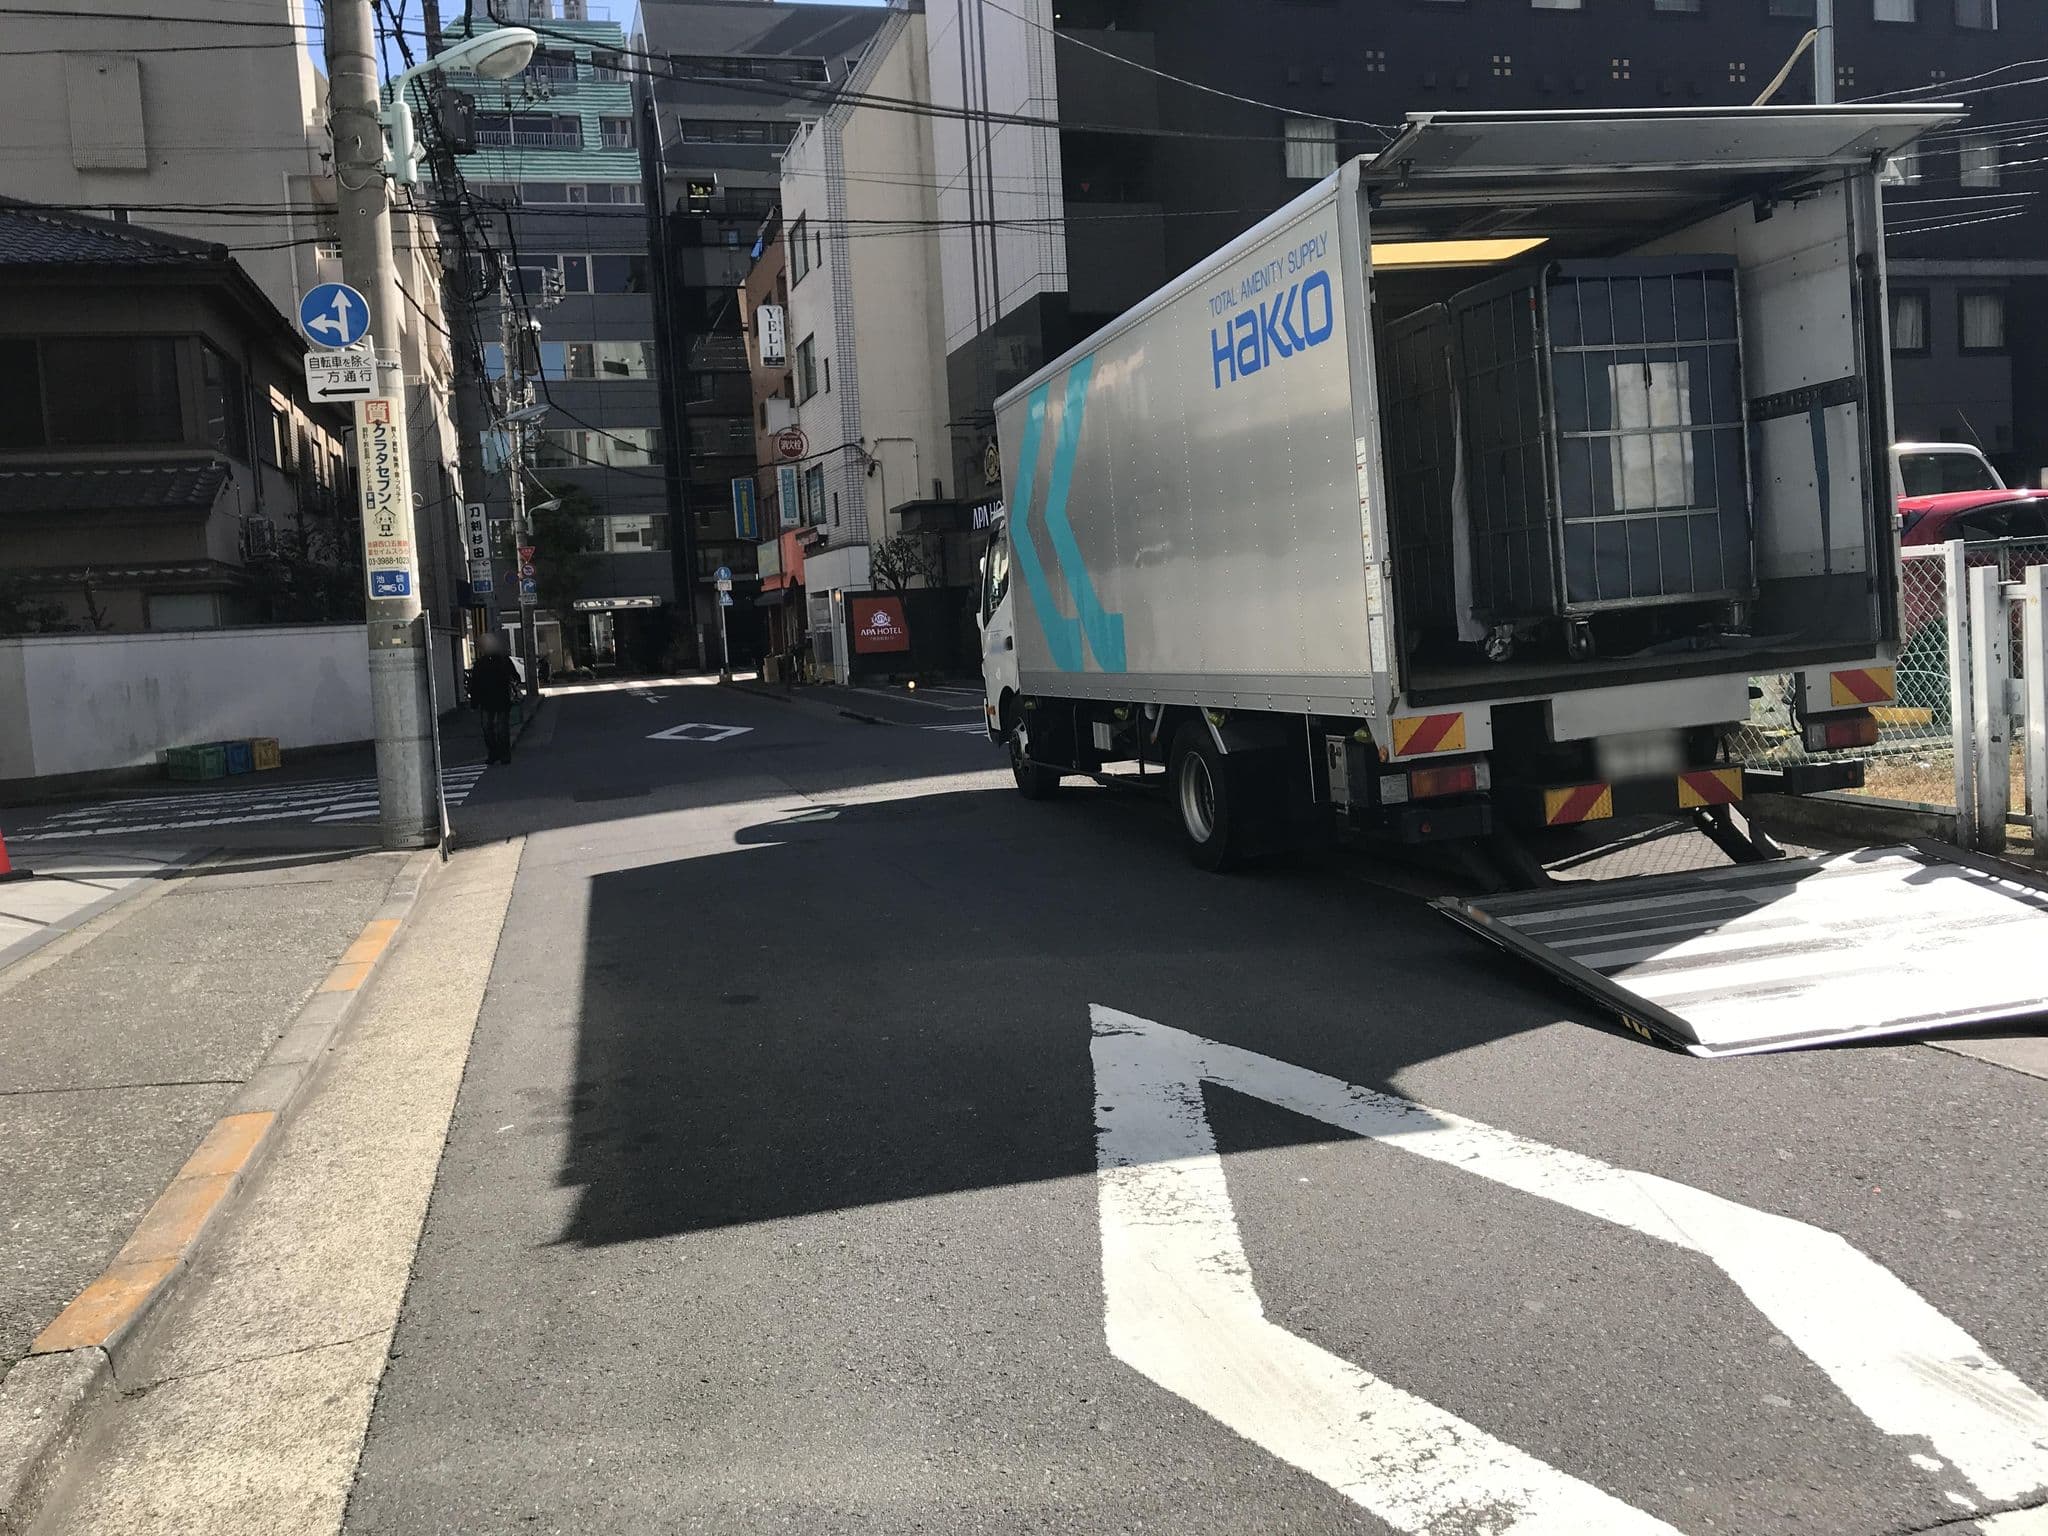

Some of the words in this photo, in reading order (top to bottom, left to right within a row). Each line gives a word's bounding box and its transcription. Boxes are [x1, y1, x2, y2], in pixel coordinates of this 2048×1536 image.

[1209, 287, 1237, 318] TOTAL
[1240, 257, 1284, 301] AMENITY
[1287, 230, 1328, 274] SUPPLY
[766, 308, 779, 357] YELL
[309, 355, 372, 369] 自転車を除く
[311, 369, 373, 383] 一方通行
[373, 423, 391, 504] クラタセブン
[973, 504, 989, 530] APA
[861, 628, 876, 636] APA
[877, 627, 902, 635] HOTEL
